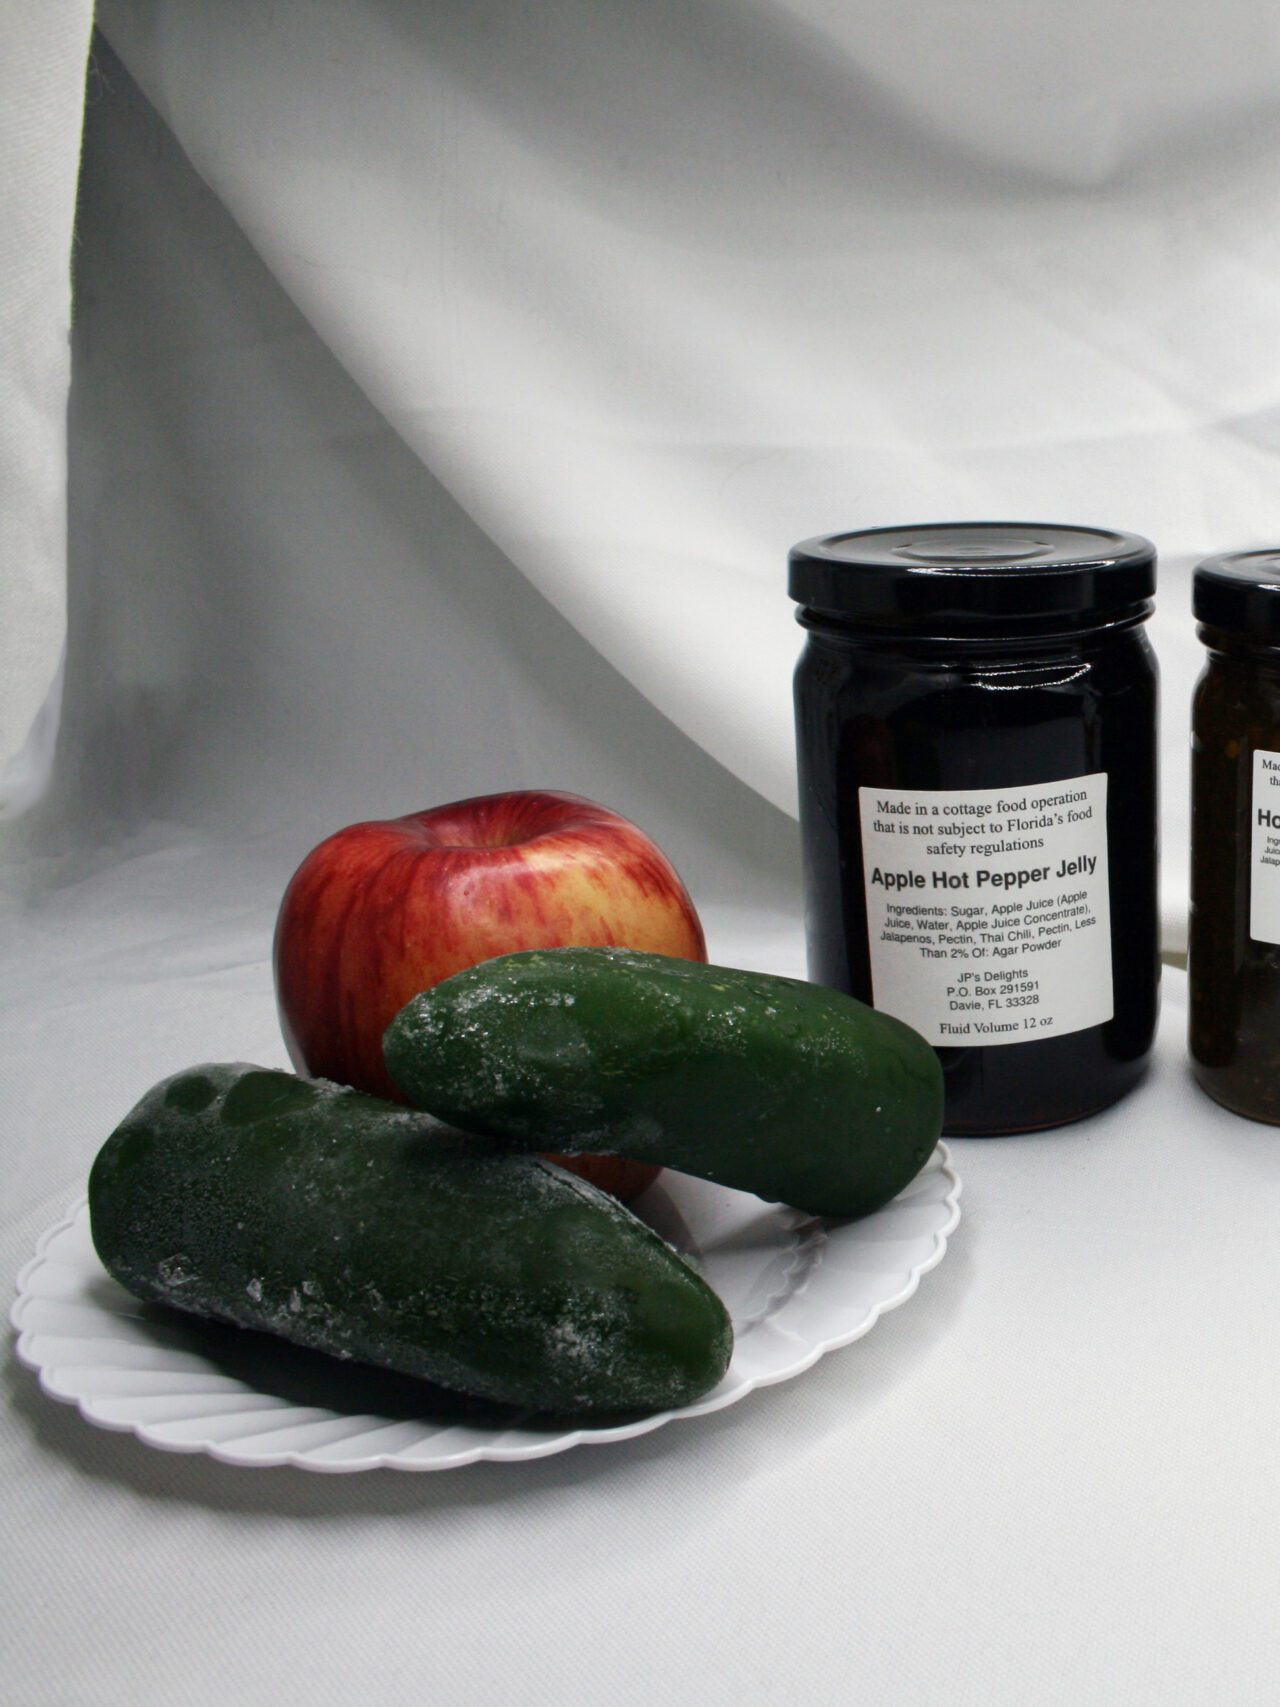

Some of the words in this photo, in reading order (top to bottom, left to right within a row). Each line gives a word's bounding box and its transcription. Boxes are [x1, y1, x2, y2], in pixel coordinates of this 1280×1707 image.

[877, 801, 911, 815] Made
[915, 803, 927, 815] in
[932, 806, 938, 815] a
[943, 804, 992, 817] cottage
[997, 799, 1027, 812] food
[1031, 790, 1087, 811] operation
[873, 820, 895, 833] that
[899, 821, 909, 834] is
[913, 824, 933, 835] not
[938, 823, 985, 838] subject
[990, 823, 1002, 833] to
[1007, 813, 1063, 832] Florida's
[1067, 807, 1092, 822] food
[926, 842, 966, 857] safety
[971, 838, 1044, 856] regulations
[872, 867, 926, 891] Apple
[933, 871, 969, 889] Hot
[977, 866, 1050, 890] Pepper
[1056, 855, 1097, 878] Jelly
[886, 904, 947, 917] Ingredients:
[951, 906, 988, 918] Sugar,
[991, 903, 1023, 915] Apple
[1026, 897, 1053, 911] Juice
[1057, 891, 1087, 906] (Apple
[885, 918, 913, 930] Juice,
[917, 920, 952, 931] Water,
[956, 919, 988, 932] Apple
[991, 917, 1020, 929] Juice
[1024, 904, 1091, 925] Concentrate),
[881, 931, 935, 945] Jalapenos,
[939, 934, 976, 945] Pectin,
[981, 932, 1004, 943] Thai
[1008, 929, 1035, 941] Chili,
[1039, 923, 1072, 937] Pectin,
[1075, 916, 1096, 929] Less
[920, 947, 947, 958] Than
[951, 948, 968, 958] 2%
[972, 947, 989, 957] Of:
[992, 945, 1017, 958] Agar
[1022, 939, 1062, 953] Powder
[957, 972, 980, 983] JP's
[984, 969, 1028, 984] Delights
[947, 986, 971, 997] P.O.
[975, 985, 996, 996] Box
[1000, 981, 1039, 994] 291591
[950, 999, 984, 1011] Davie,
[989, 999, 1002, 1009] FL
[1006, 994, 1039, 1008] 33328
[940, 1022, 970, 1034] Fluid
[974, 1022, 1019, 1033] Volume
[1023, 1017, 1036, 1029] 12
[1040, 1016, 1053, 1026] oz
